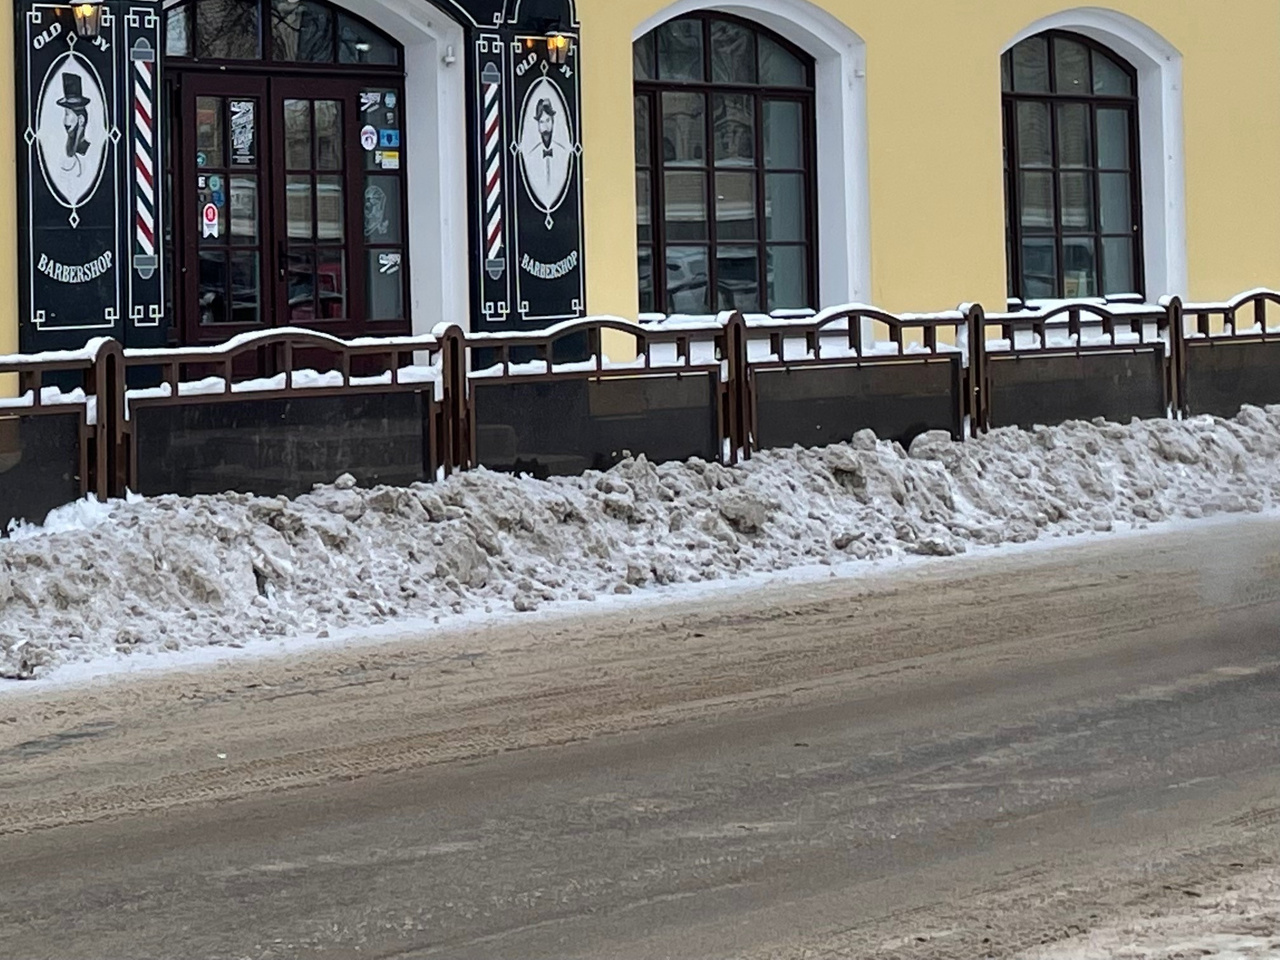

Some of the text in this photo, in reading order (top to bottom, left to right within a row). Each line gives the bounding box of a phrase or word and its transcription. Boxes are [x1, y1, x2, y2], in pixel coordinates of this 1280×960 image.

[33, 22, 62, 50] OLD
[516, 52, 537, 76] OLD
[37, 250, 113, 283] BARBERSHOP
[521, 250, 578, 279] BARBERSHOP
